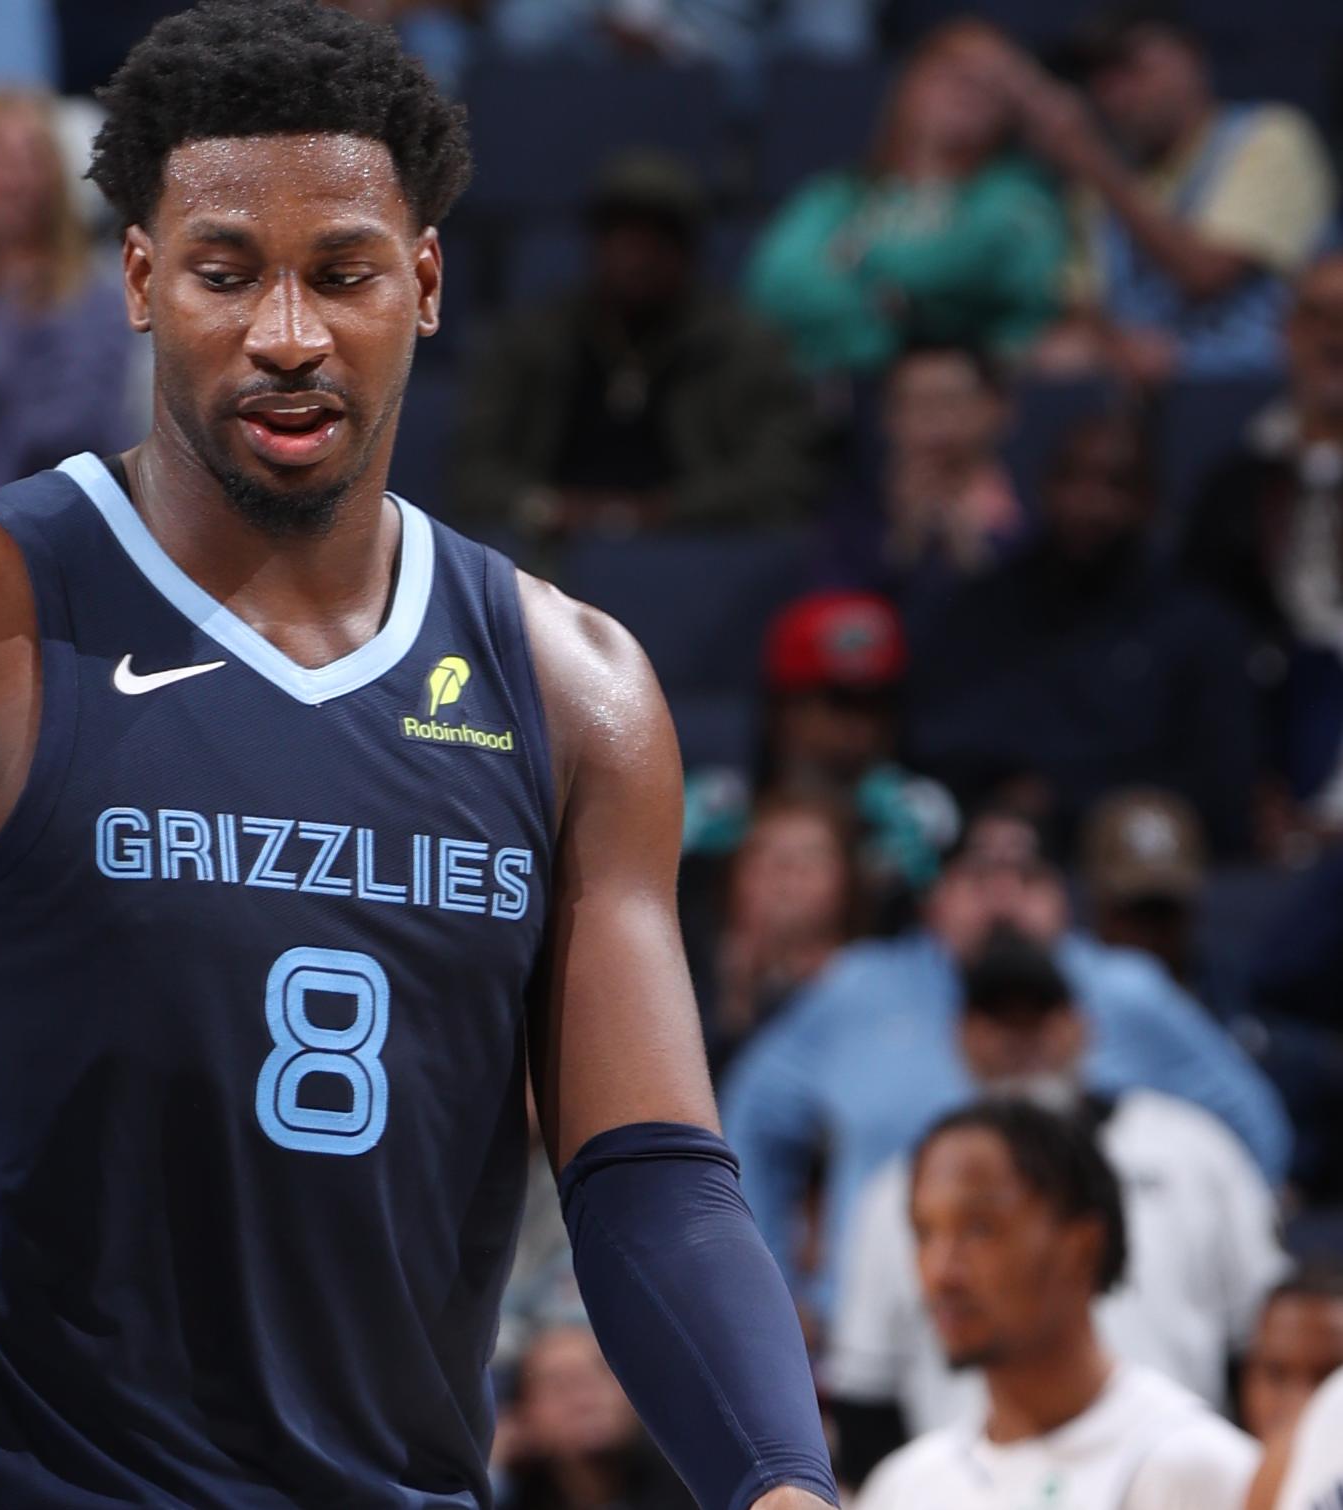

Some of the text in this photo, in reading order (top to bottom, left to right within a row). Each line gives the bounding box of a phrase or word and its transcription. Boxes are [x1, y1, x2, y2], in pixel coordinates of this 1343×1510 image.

[403, 717, 514, 750] Robinhood
[96, 807, 533, 920] GRIZZLIES
[255, 946, 390, 1156] 8
